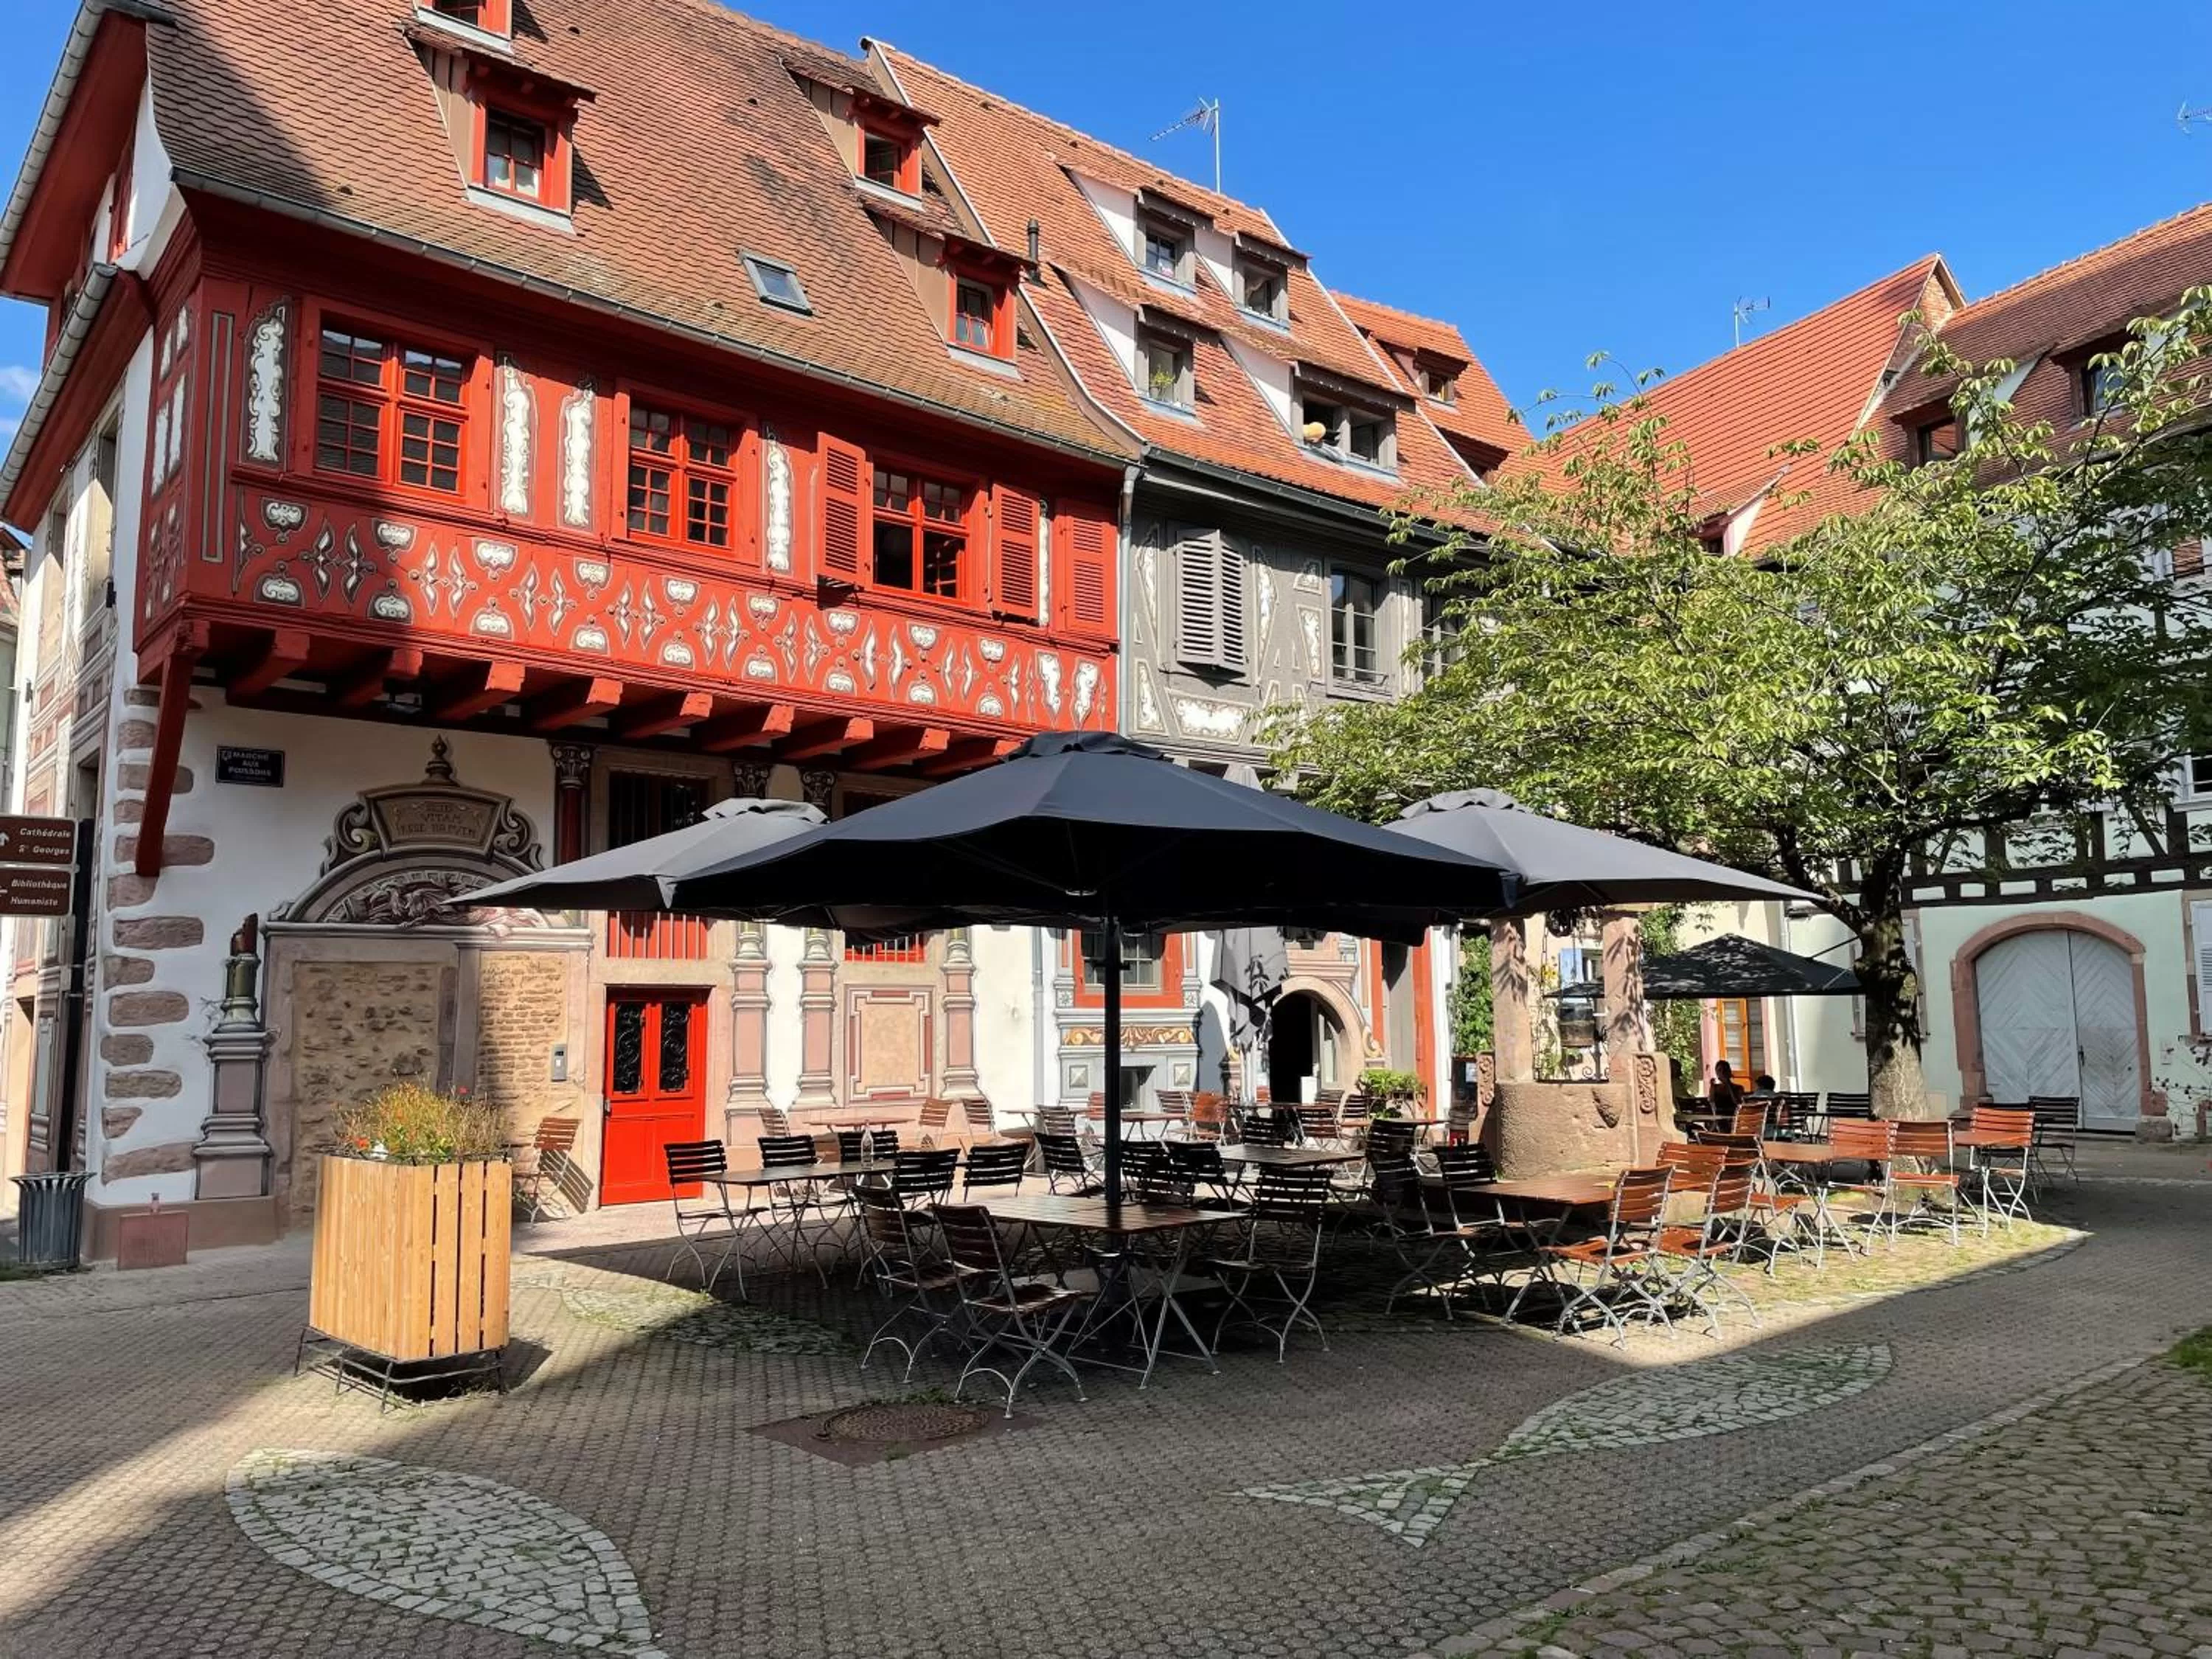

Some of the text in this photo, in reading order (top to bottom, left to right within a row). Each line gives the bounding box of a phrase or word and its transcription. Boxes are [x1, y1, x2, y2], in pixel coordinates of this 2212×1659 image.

[20, 827, 72, 838] Cathédrale
[32, 845, 70, 856] Georges
[11, 878, 67, 889] Bibliothèque
[10, 896, 58, 906] Humaniste
